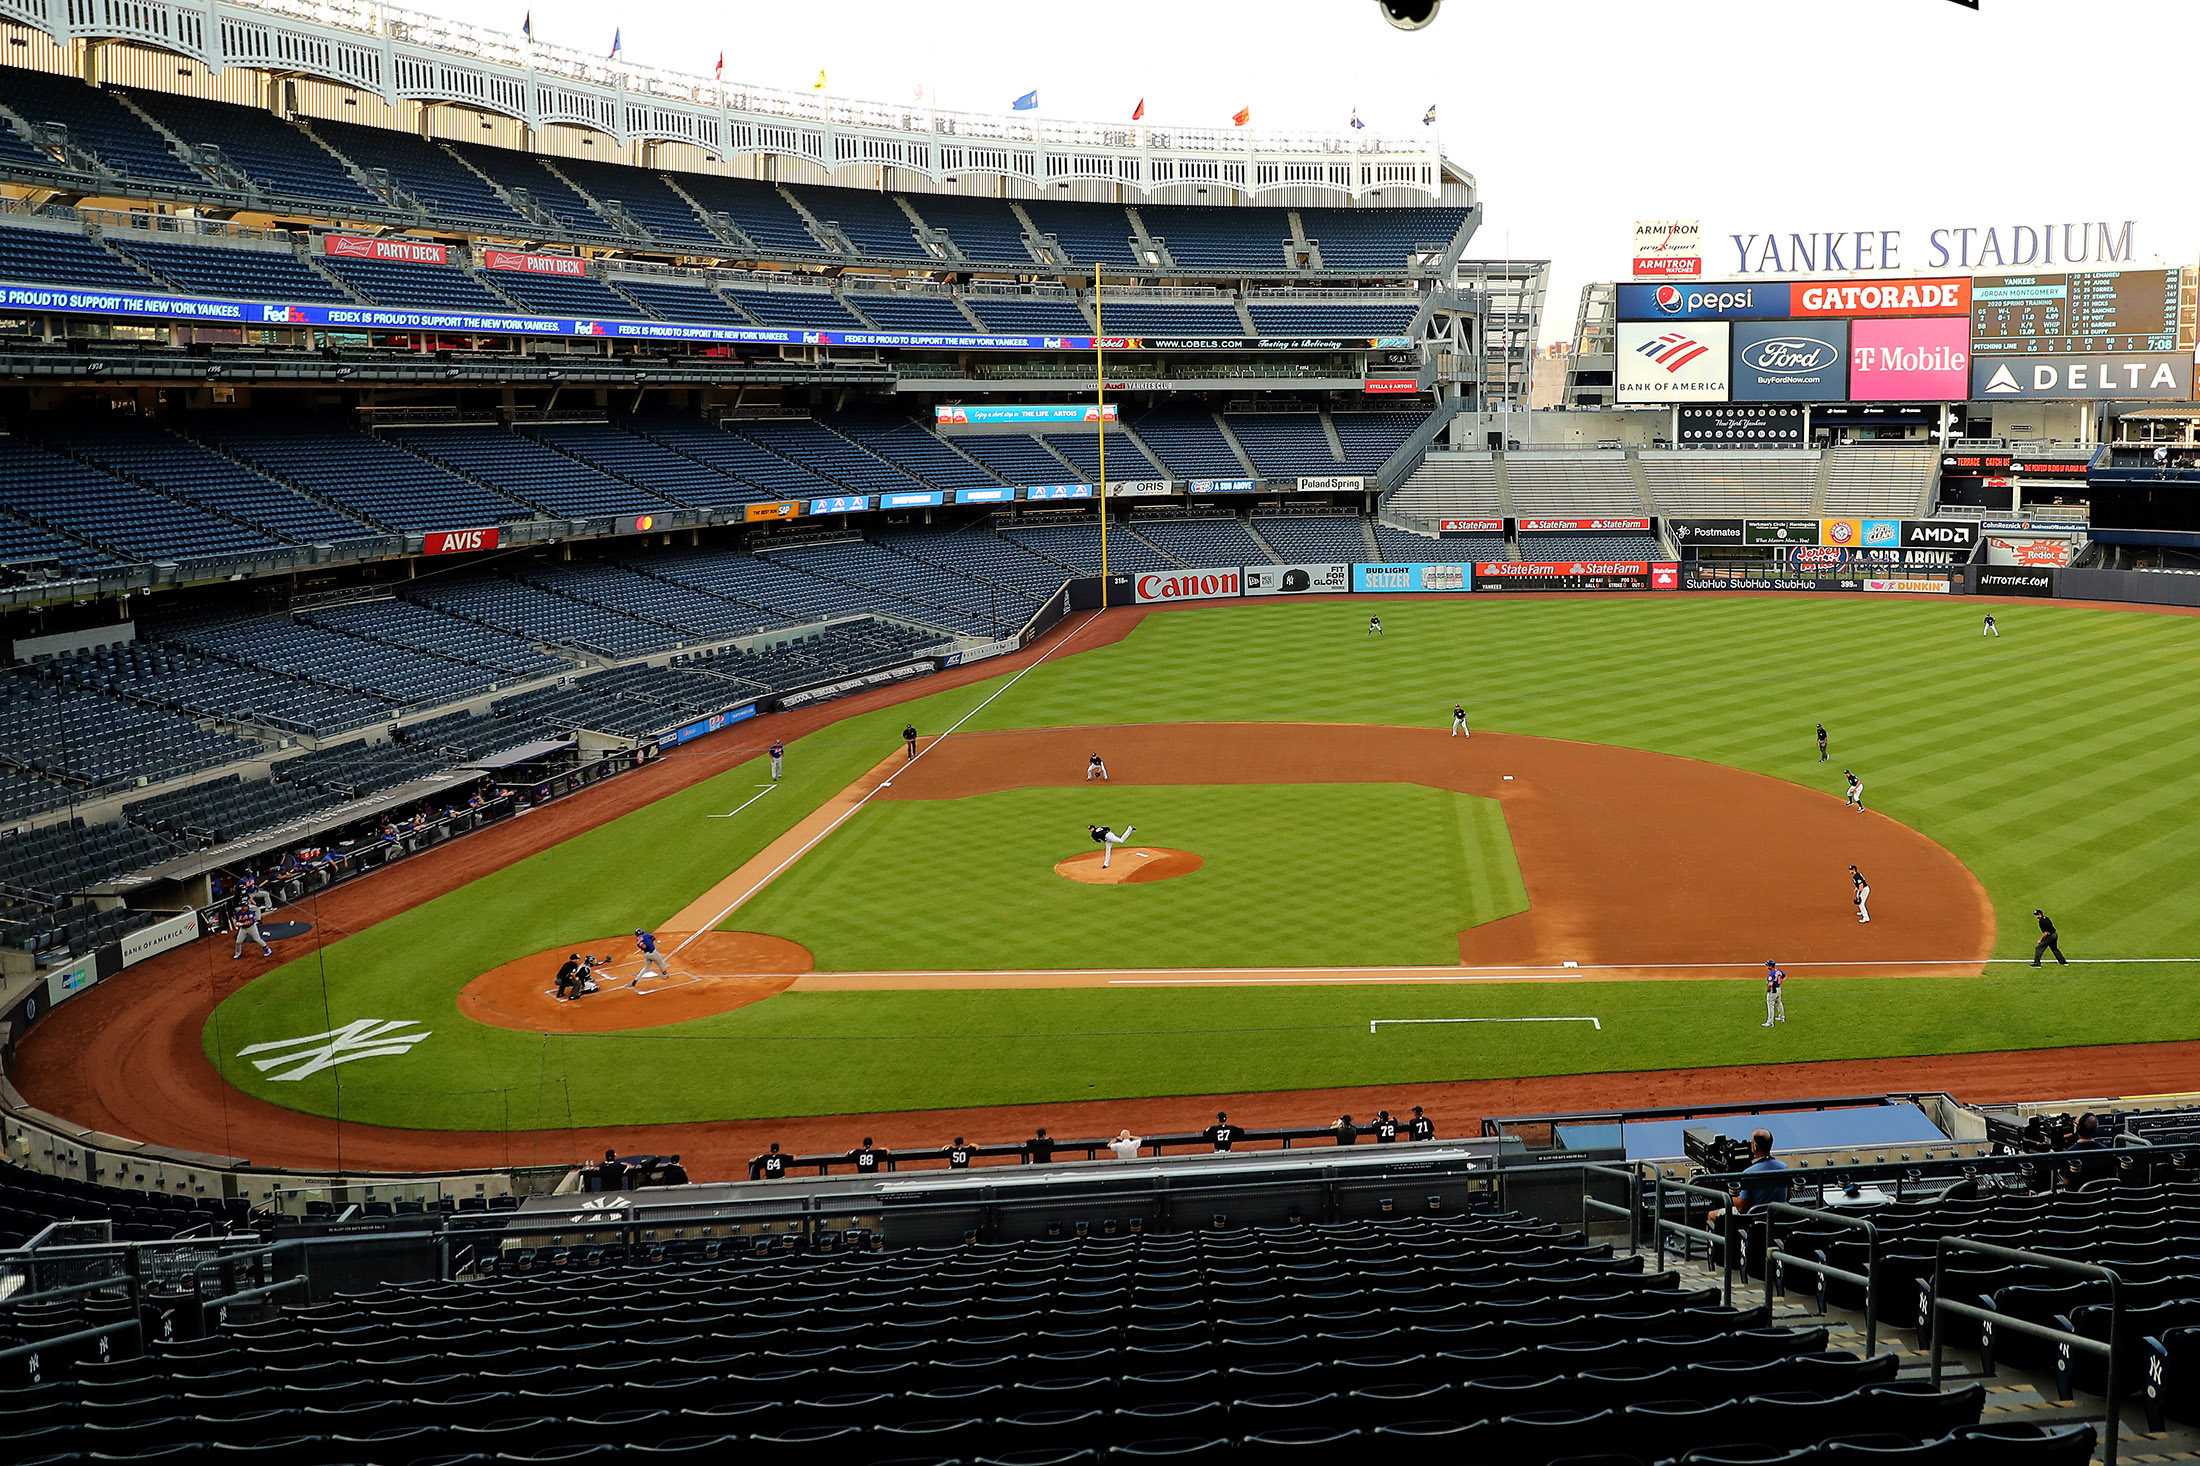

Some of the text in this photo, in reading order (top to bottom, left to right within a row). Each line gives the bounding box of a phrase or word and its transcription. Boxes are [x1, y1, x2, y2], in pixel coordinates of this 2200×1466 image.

[1636, 225, 1699, 234] ARMITRON
[376, 243, 410, 259] PARTY
[412, 245, 440, 261] DECK
[1729, 220, 2137, 273] YANKEE STADIUM
[527, 257, 555, 272] PARTY
[556, 260, 580, 274] DECK
[1638, 260, 1696, 268] ARMITRON
[2004, 278, 2036, 286] YANKEES
[1687, 288, 1753, 318] pepsi
[1802, 284, 1960, 311] GATORADE
[8, 291, 51, 306] PROUD
[51, 293, 68, 306] TO
[69, 295, 121, 310] SUPPORT
[123, 298, 144, 311] THE
[145, 300, 170, 312] NEW
[170, 301, 198, 315] YORK
[197, 303, 241, 318] YANKEES.
[328, 311, 560, 332] FEDEX IS PROUD TO SUPPORT THE NEW YORK YANKEES.
[618, 325, 641, 335] FEDEX
[641, 326, 649, 335] IS
[649, 327, 673, 336] PROUD
[673, 327, 682, 337] TO
[682, 328, 712, 338] SUPPORT
[712, 329, 725, 338] THE
[725, 330, 739, 339] NEW
[739, 330, 759, 340] YORK
[845, 335, 868, 344] FEDEX
[868, 335, 875, 344] IS
[876, 336, 900, 344] PROUD
[900, 336, 910, 344] TO
[910, 337, 944, 345] SUPPORT
[944, 337, 959, 345] THE
[959, 338, 976, 346] NEW
[976, 338, 995, 346] YORK
[1155, 340, 1242, 348] WWW.LOBELS.COM
[2147, 340, 2173, 350] 7:08
[1758, 341, 1822, 369] Ford
[1757, 376, 1820, 385] BuyFordNow.com
[2033, 363, 2177, 390] DELTA
[1126, 382, 1157, 390] YANKEES
[1156, 382, 1172, 390] CLUB
[1620, 382, 1725, 391] BANK OF AMERICA
[1956, 457, 2003, 466] TERRACE CATCH
[1136, 481, 1165, 492] ORIS
[1233, 480, 1253, 491] ABOVE
[1301, 478, 1360, 490] Poland Spring
[778, 505, 790, 516] SAP
[1694, 527, 1741, 537] Postmates
[1983, 522, 2021, 530] CohnReznick
[1910, 528, 1954, 542] AMD
[441, 532, 482, 552] AVIS
[1798, 546, 1841, 558] Jersey
[2027, 551, 2055, 560] RedHot
[1114, 577, 1125, 585] 318
[1137, 572, 1238, 600] Canon
[1365, 573, 1411, 588] SELTZER
[1686, 579, 1727, 589] StubHub
[1730, 579, 1771, 589] StubHub
[1774, 579, 1816, 590] StubHub
[1898, 582, 1944, 591] DUNKIN'
[1981, 575, 2048, 588] NITTOTIRE.COM
[660, 732, 678, 745] GEICO
[124, 929, 183, 957] BANK OF AMERICA
[1380, 1125, 1395, 1137] 72
[1416, 1121, 1429, 1133] 71
[1217, 1129, 1231, 1141] 27
[859, 1154, 873, 1165] 88
[952, 1151, 966, 1163] 50
[766, 1158, 781, 1170] 64
